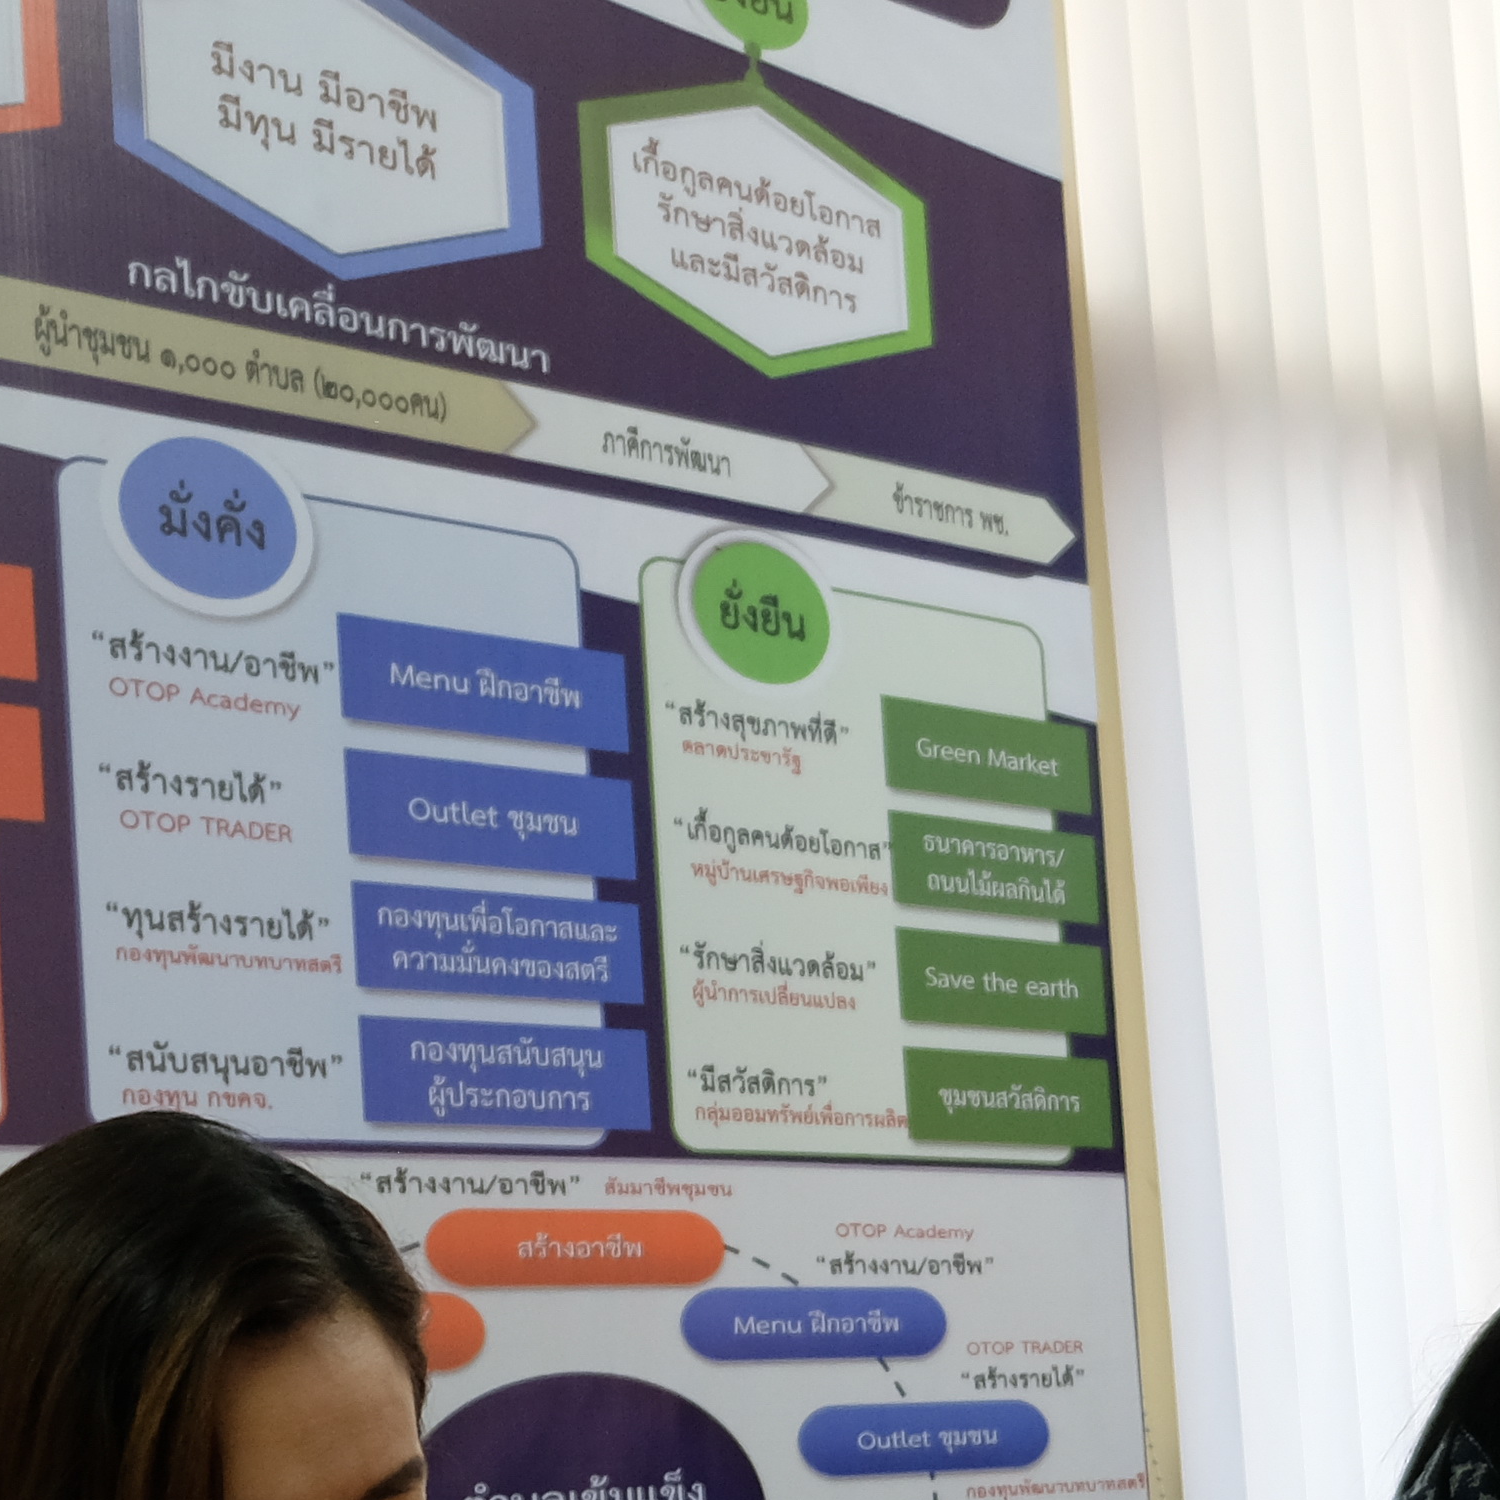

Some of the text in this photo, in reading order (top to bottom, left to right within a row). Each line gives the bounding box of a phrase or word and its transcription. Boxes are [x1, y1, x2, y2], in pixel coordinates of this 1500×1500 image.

[211, 40, 438, 133] มีงาน มีอาชีพ
[218, 94, 437, 181] มีทุน มีรายได้
[631, 136, 882, 239] เกื้อกูลคนด้อยโอกาส
[657, 192, 864, 275] รักษาสิ่งแวดล้อม
[671, 245, 857, 314] และมีสวัสดิการ
[127, 257, 550, 374] กลไกขับเคลื่อนการพัฒนา
[33, 304, 151, 367] ผู้นำชุมชน
[159, 345, 237, 380] ๑,๐๐๐
[245, 347, 306, 394] ตำบล
[601, 426, 732, 479] ภาคีการพัฒนา
[158, 479, 266, 551] มั่งคั่ง
[892, 481, 974, 529] ข้าราชการ
[719, 578, 807, 643] ยั่งยืน
[109, 676, 301, 721] OTOP Academy
[390, 662, 583, 710] Menu ฝึกอาชีพ
[916, 737, 1059, 777] Green Market
[119, 809, 293, 843] OTOP TRADER
[408, 797, 579, 842] Outlet ชุมชน
[377, 899, 618, 943] กองทุนเพื่อโอกาสและ
[392, 939, 610, 984] ความมั่นคงของสตรี
[925, 966, 1079, 999] Save the earth
[410, 1036, 603, 1079] กองทุนสนับสนุน
[122, 1087, 198, 1111] กองทุน
[428, 1074, 592, 1118] ผู้ประกอบการ
[938, 1083, 1080, 1114] ชุมชนสวัสดิการ
[517, 1232, 644, 1260] สร้างอาชีพ
[835, 1222, 975, 1242] OTOP Academy
[734, 1309, 900, 1335] Menu ฝึกอาชีพ
[966, 1340, 1084, 1356] OTOP TRADER
[857, 1428, 998, 1454] Outlet ชุมชน
